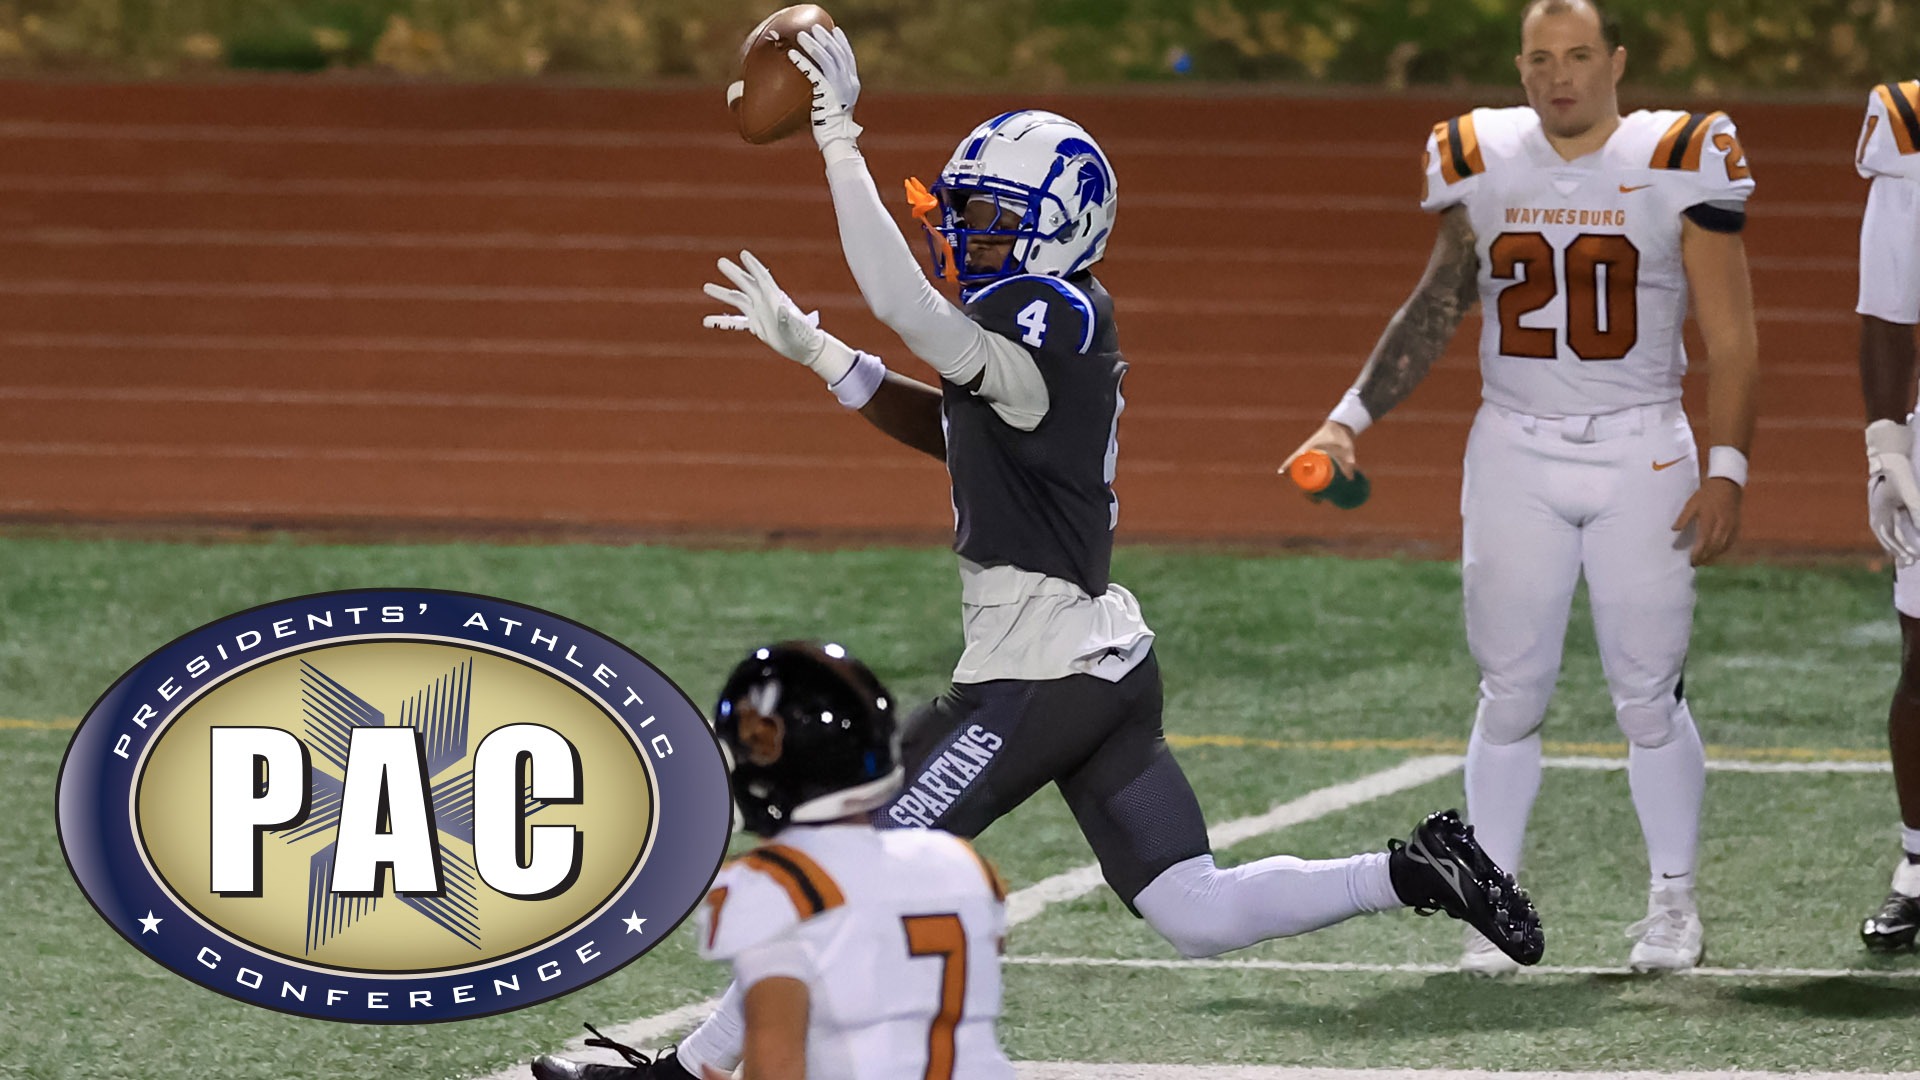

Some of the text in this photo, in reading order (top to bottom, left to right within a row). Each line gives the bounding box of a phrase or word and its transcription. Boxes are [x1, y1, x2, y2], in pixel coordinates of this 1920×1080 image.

[1505, 207, 1625, 226] WAYNESBURG
[1016, 299, 1048, 348] 4
[1489, 232, 1639, 361] 20
[888, 724, 1003, 830] SPARTANS
[901, 913, 968, 1080] 7
